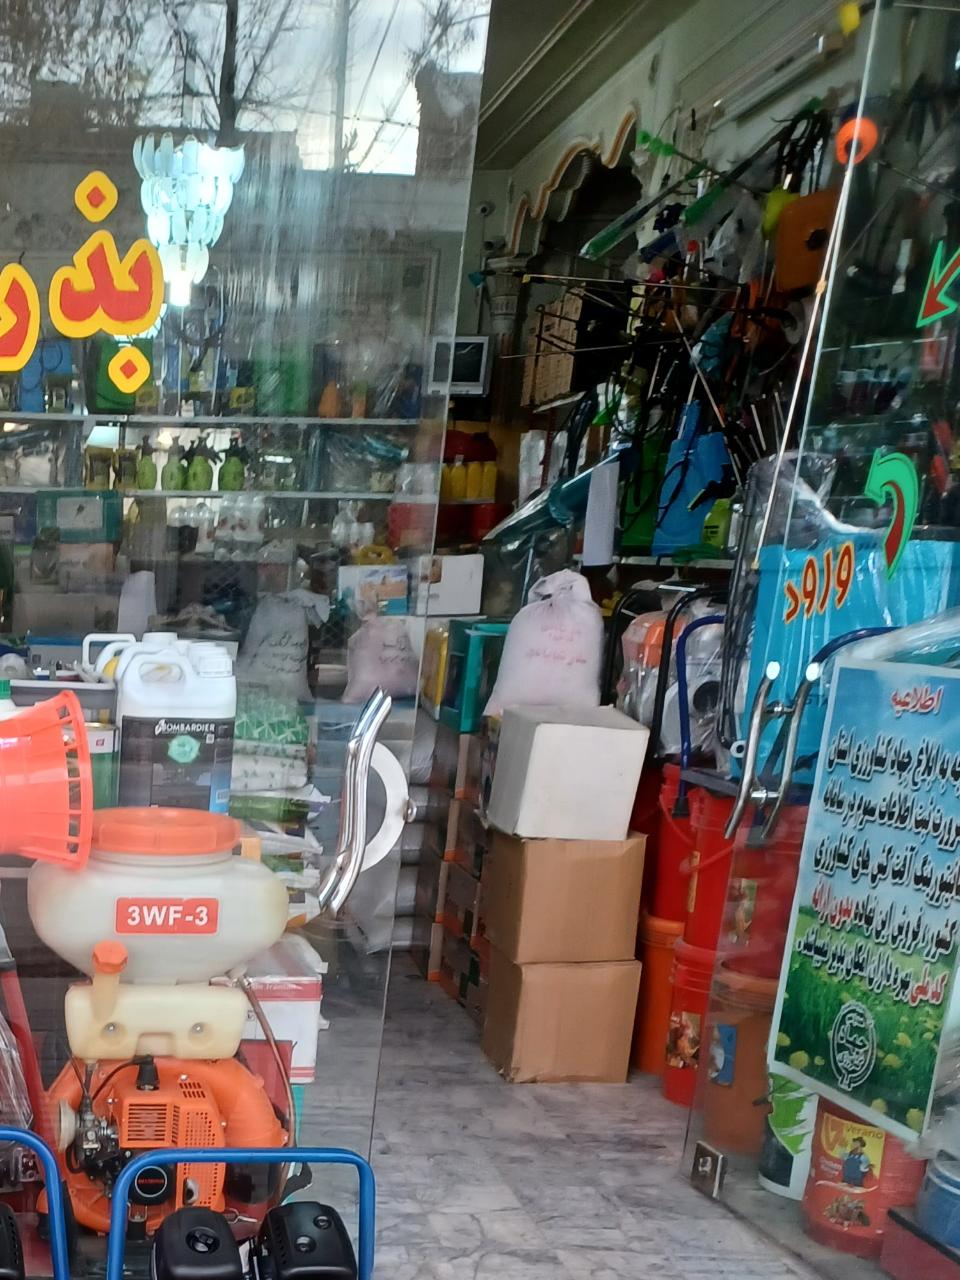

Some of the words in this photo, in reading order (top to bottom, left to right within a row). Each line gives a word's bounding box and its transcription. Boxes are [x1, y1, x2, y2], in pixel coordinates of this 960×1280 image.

[784, 541, 855, 624] ورود
[892, 685, 944, 717] اطلاعیه
[827, 727, 855, 772] استان
[851, 734, 892, 780] کشاورزی
[890, 739, 913, 788] جهاد
[912, 738, 941, 790] ابلاغ
[842, 791, 857, 827] در
[878, 790, 914, 829] اطلاعات
[914, 798, 934, 842] ثبت
[932, 808, 960, 850] رورت
[814, 833, 855, 876] کشاورزی
[851, 840, 871, 883] های
[870, 843, 893, 888] کش
[891, 846, 916, 885] آفت
[127, 905, 208, 926] 3WF-3
[830, 896, 854, 931] بدون
[853, 894, 877, 936] نهاده
[874, 902, 894, 943] این
[892, 906, 924, 954] فروش
[846, 938, 870, 980] امکان
[909, 964, 930, 1006] ملی
[929, 971, 949, 1005] کد
